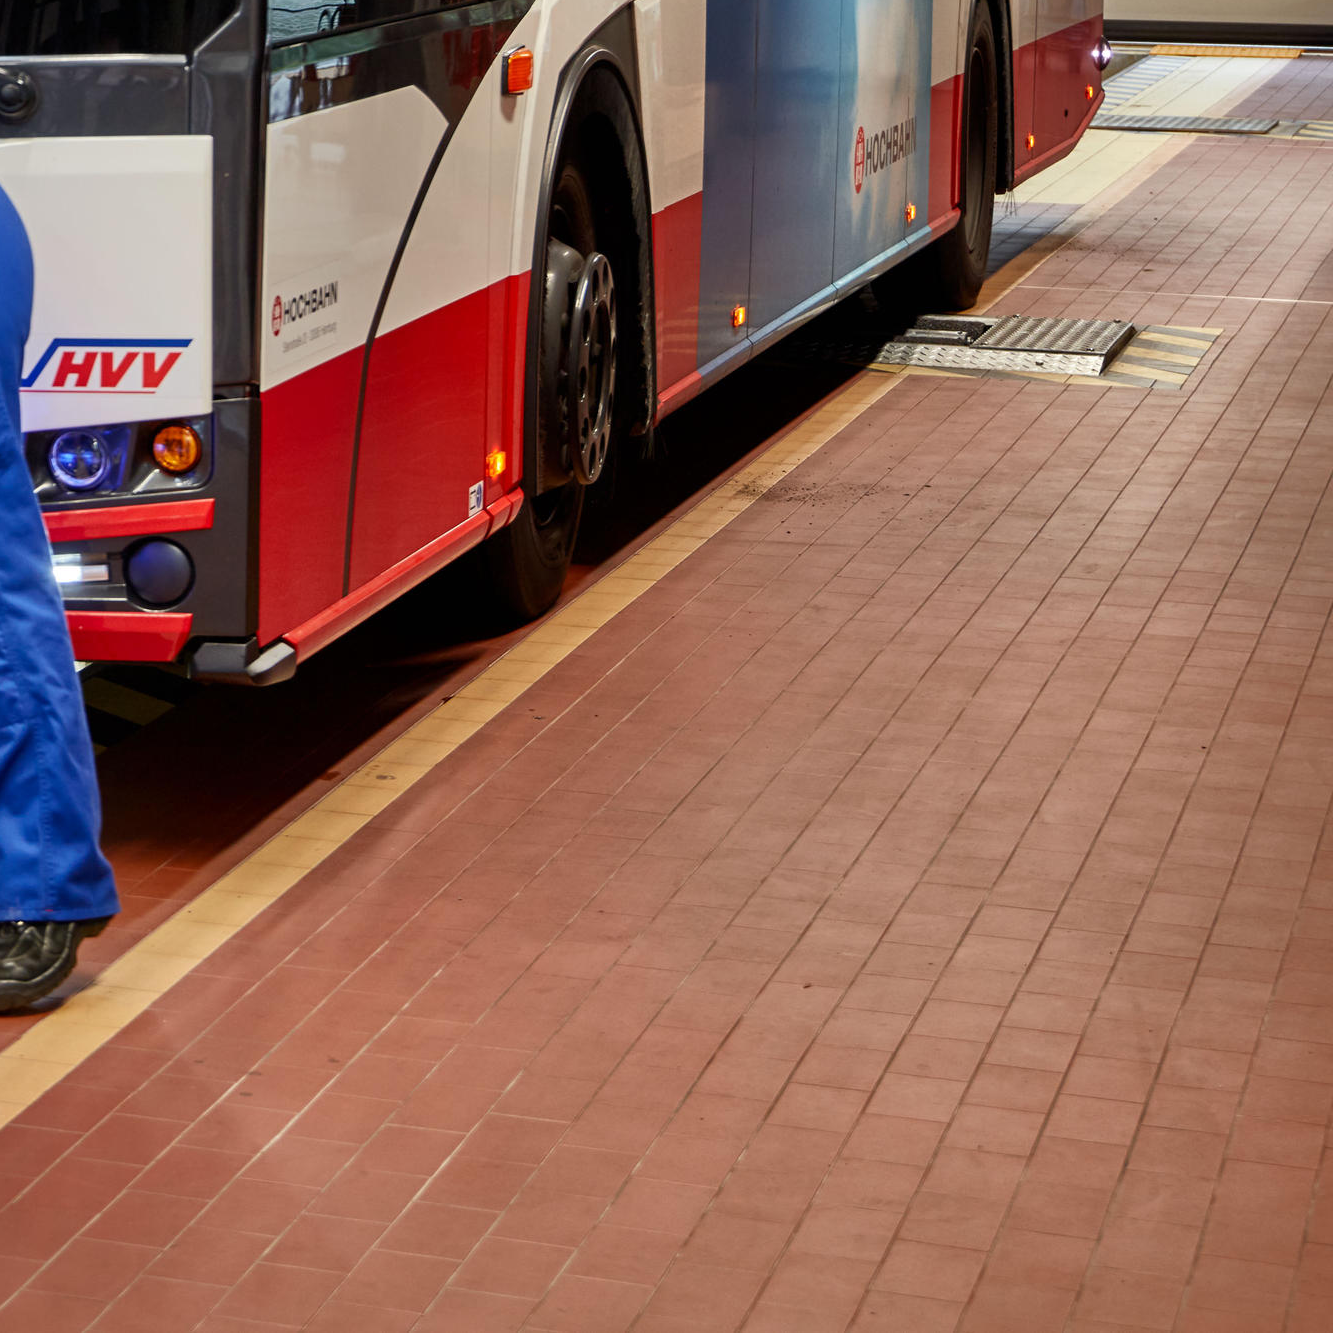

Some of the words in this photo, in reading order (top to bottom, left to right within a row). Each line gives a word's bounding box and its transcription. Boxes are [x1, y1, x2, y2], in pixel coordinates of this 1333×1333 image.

[865, 115, 917, 177] HOCHBAHN
[283, 280, 338, 325] HOCHBAHN
[52, 351, 183, 388] HVV
